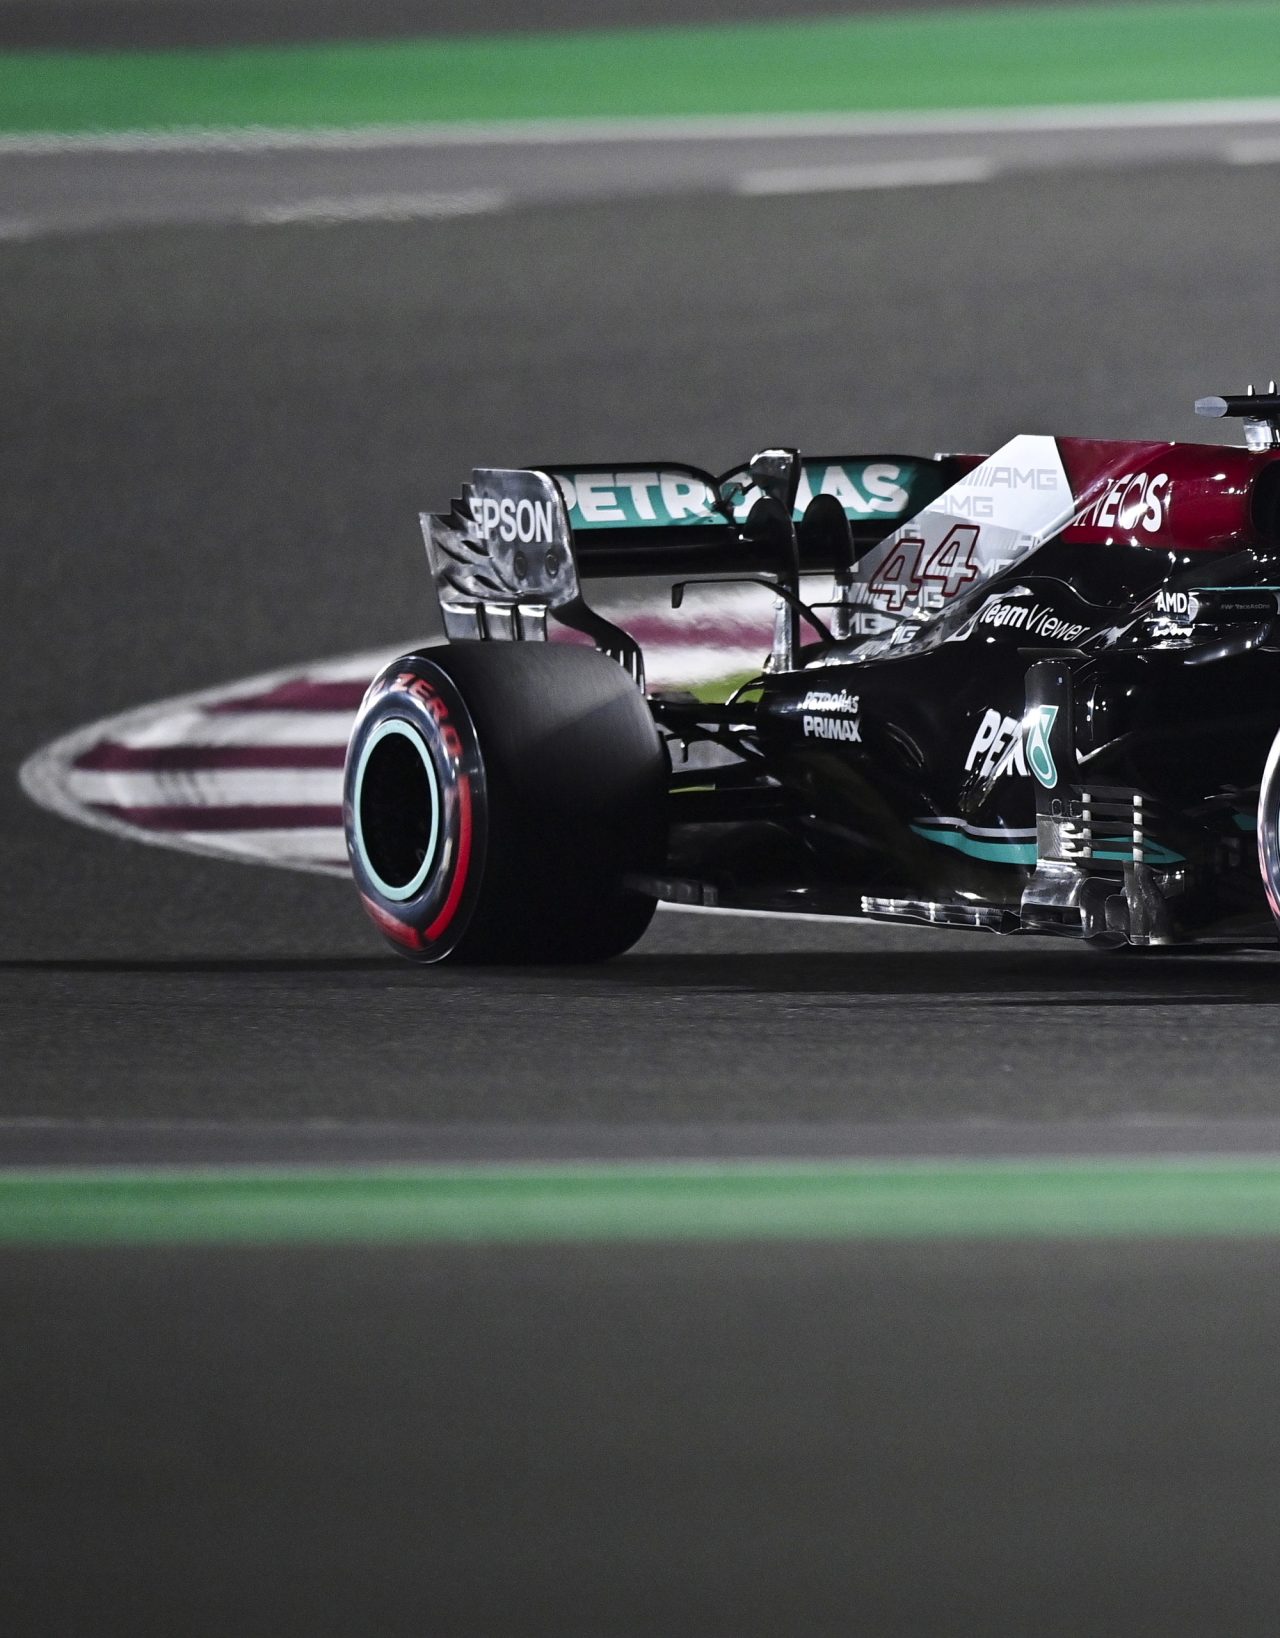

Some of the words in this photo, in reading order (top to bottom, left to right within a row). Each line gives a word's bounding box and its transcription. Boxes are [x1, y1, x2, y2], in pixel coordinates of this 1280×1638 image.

[556, 463, 909, 521] ETROAS
[989, 466, 1058, 491] AMG
[470, 497, 553, 543] EPSON
[868, 523, 981, 611] 44
[980, 599, 1091, 641] TeamViewer
[1156, 592, 1188, 613] AMD
[803, 715, 862, 742] PRIMAX
